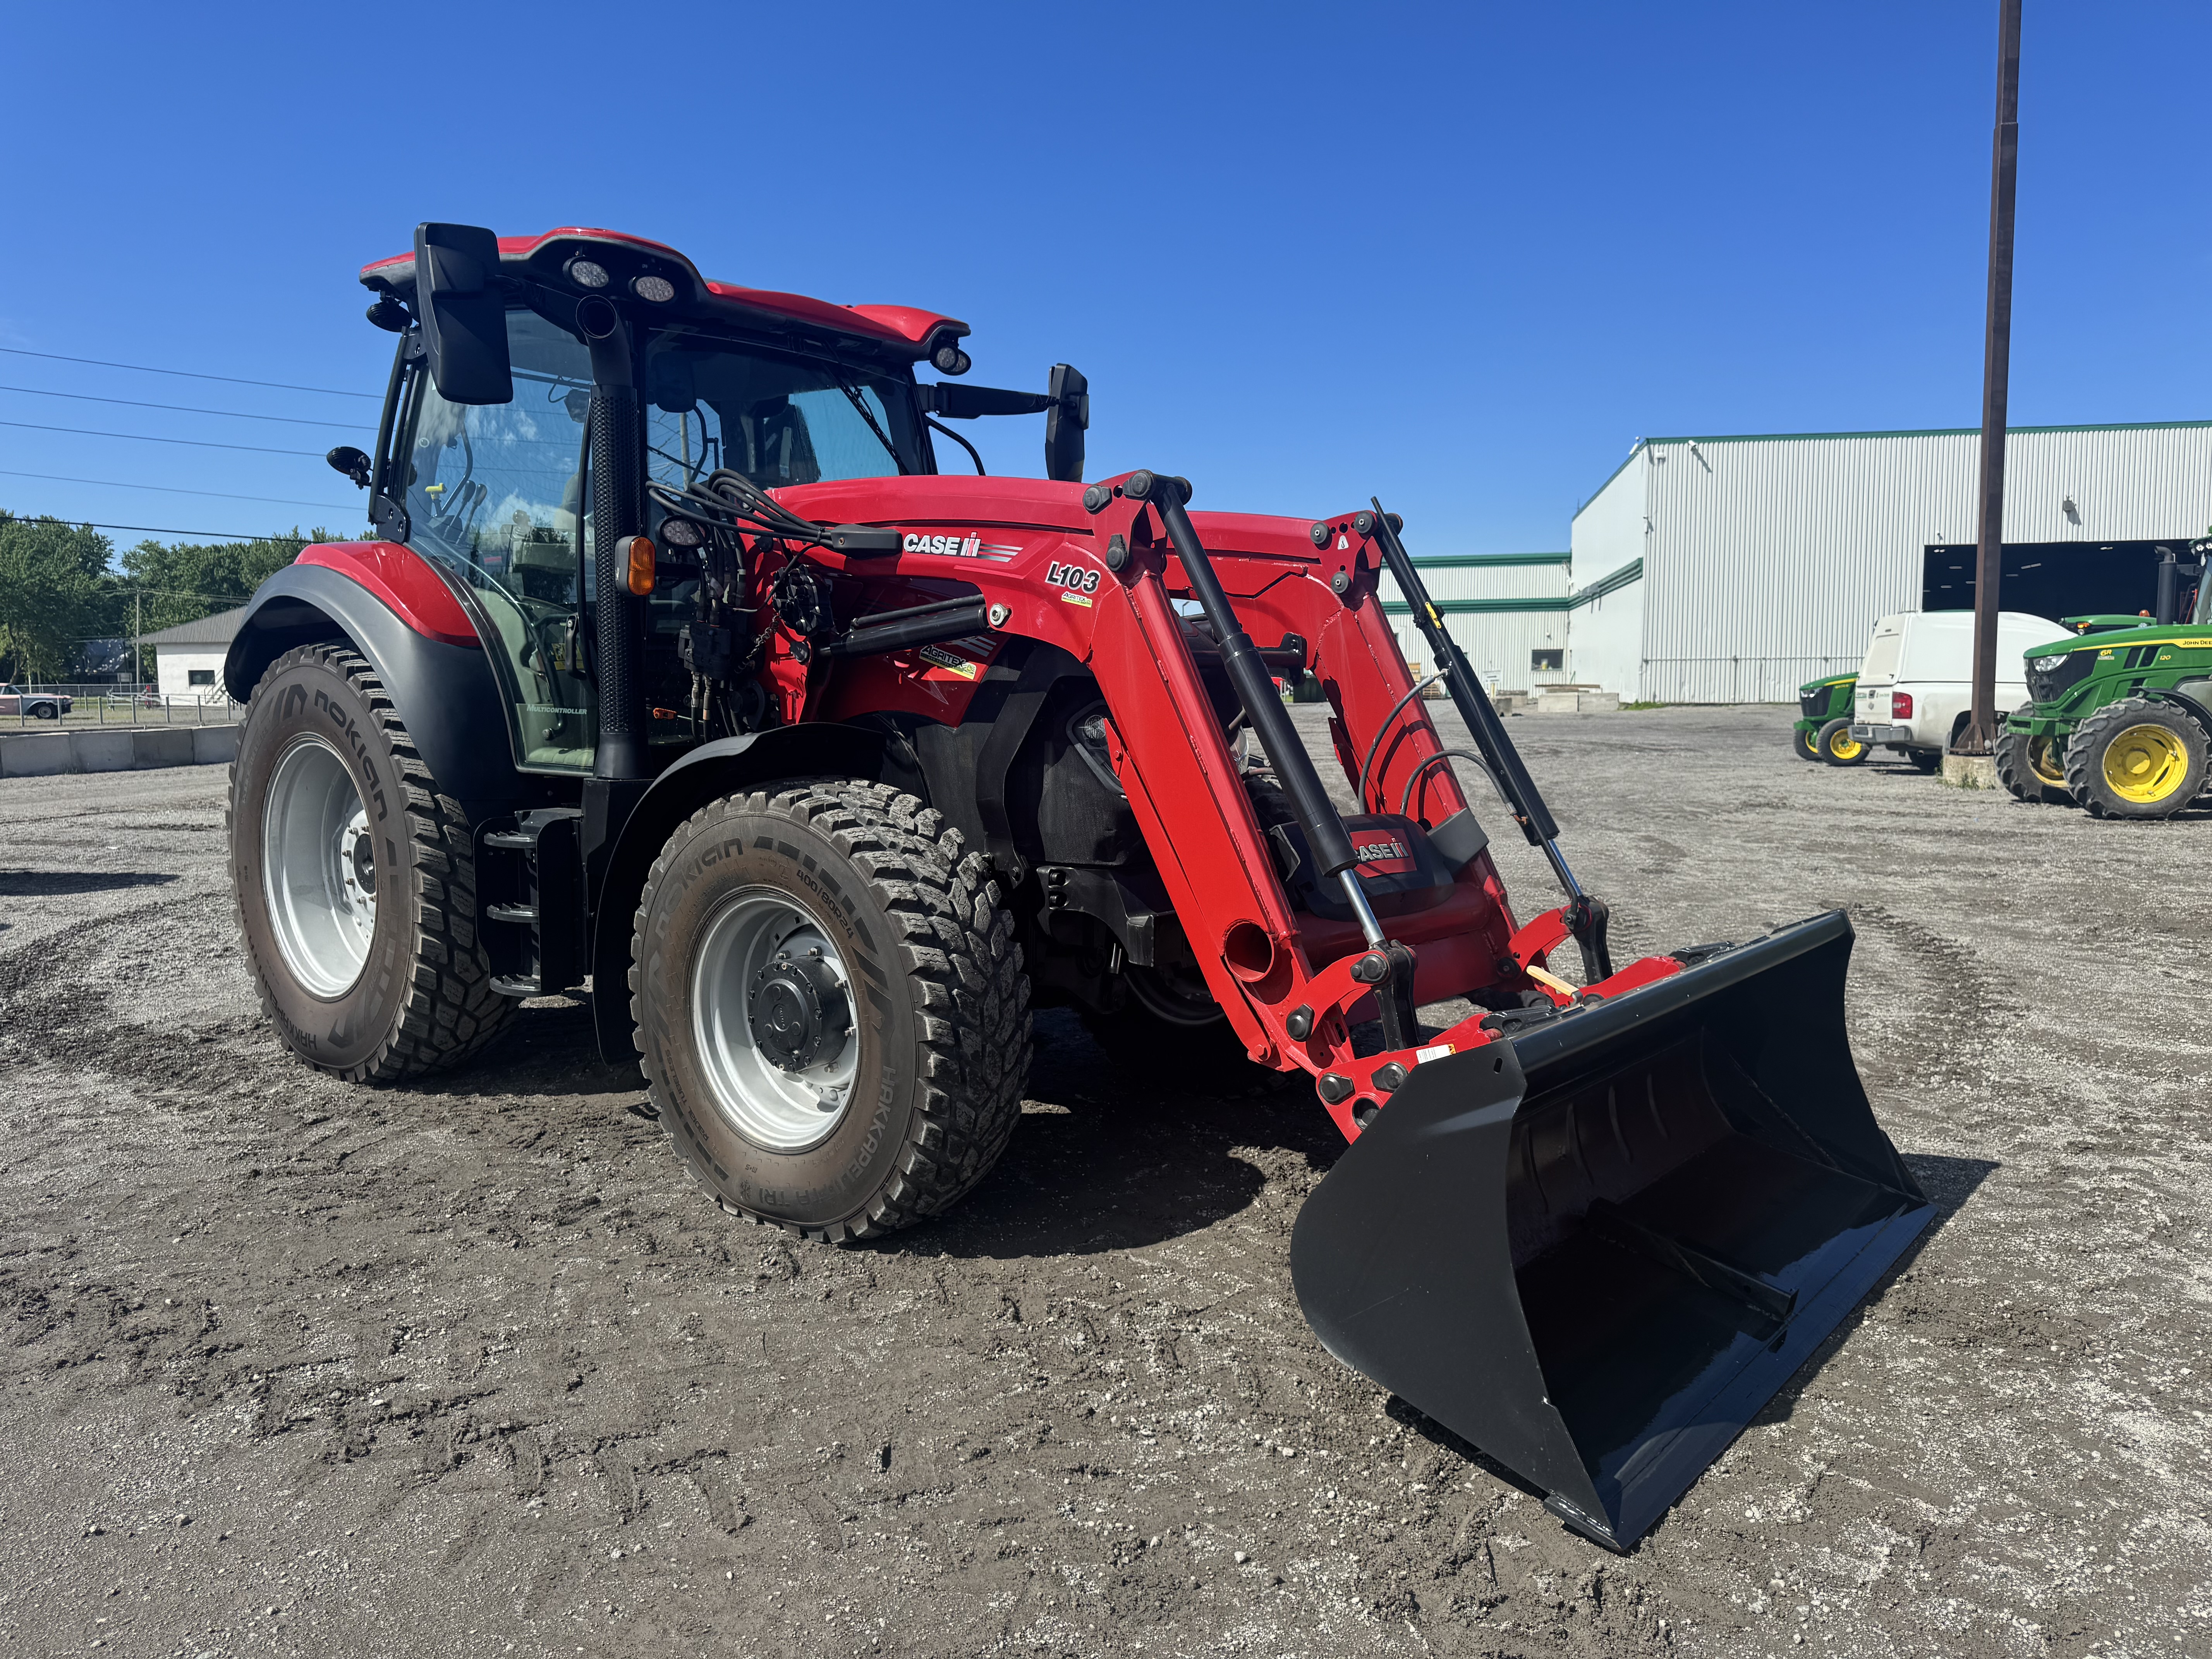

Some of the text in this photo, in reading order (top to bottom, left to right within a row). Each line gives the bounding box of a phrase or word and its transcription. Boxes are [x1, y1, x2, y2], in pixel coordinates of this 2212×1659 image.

[903, 533, 960, 555] CASE
[1045, 561, 1101, 593] L103
[1063, 592, 1086, 601] AGRITEX
[922, 645, 965, 668] AGRITEX
[1356, 844, 1394, 862] ASE
[796, 869, 854, 939] 400/80R24
[665, 1049, 687, 1106] TUBELESS
[759, 1187, 791, 1207] TRI
